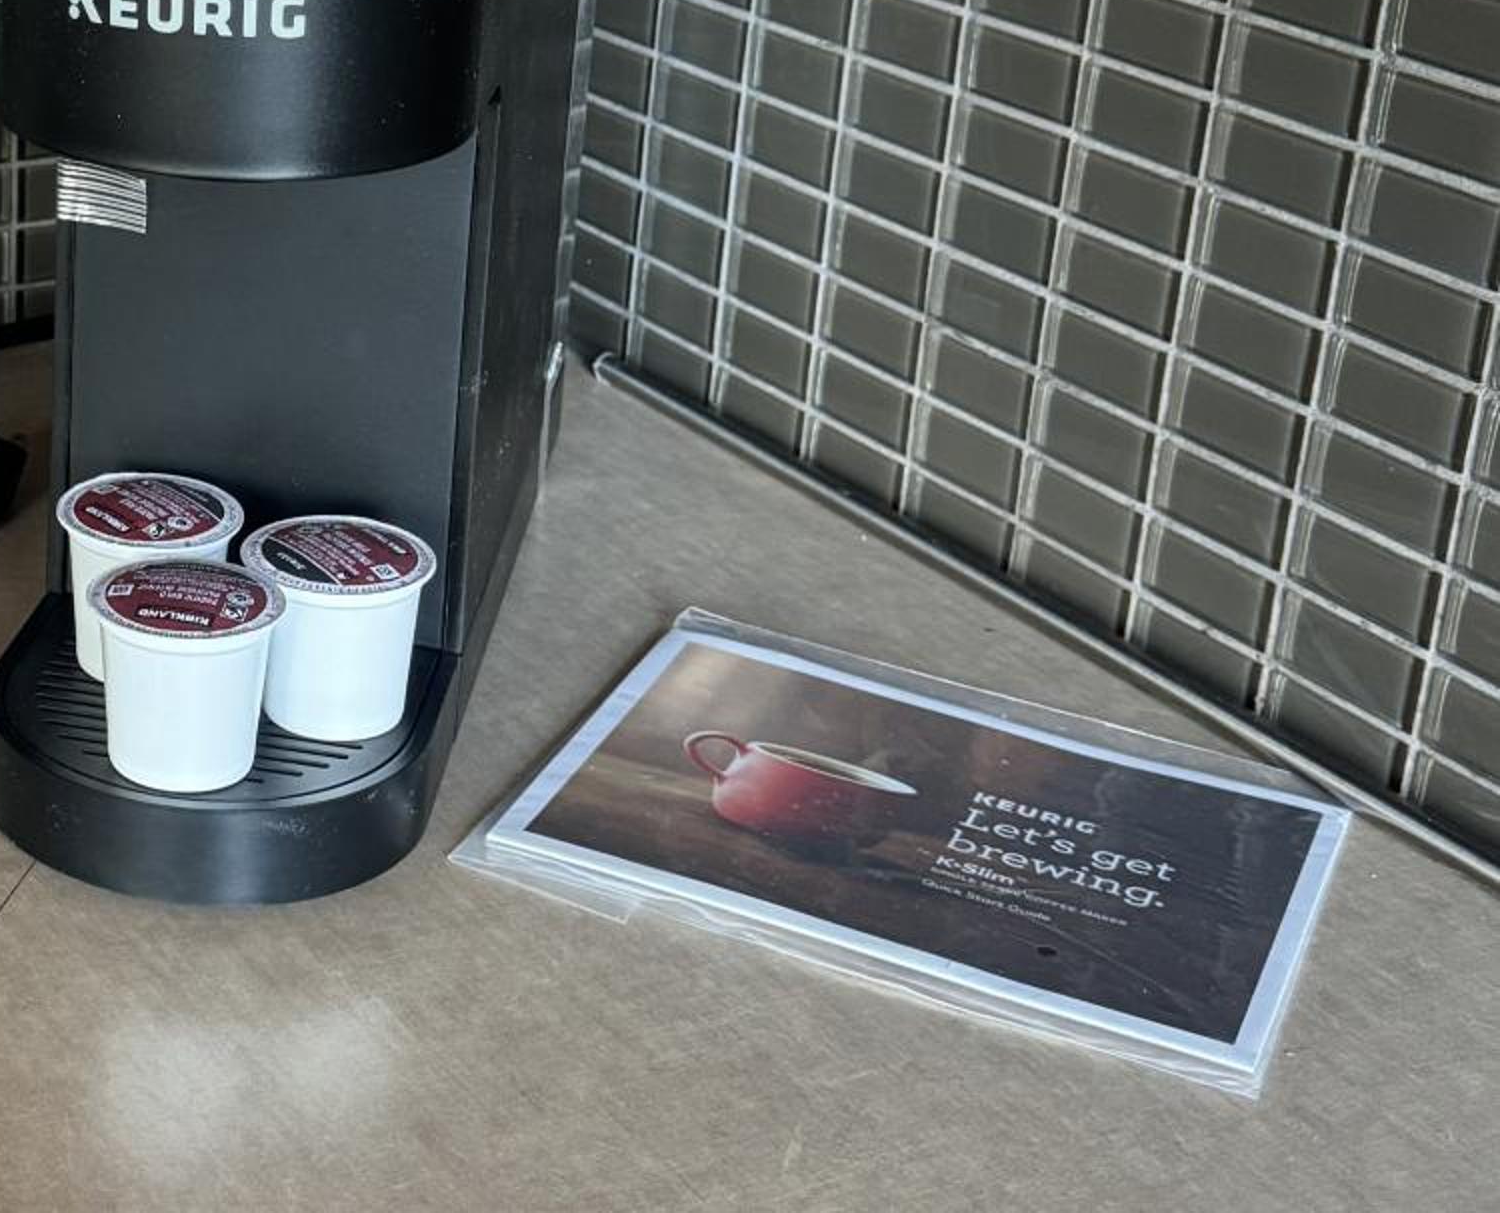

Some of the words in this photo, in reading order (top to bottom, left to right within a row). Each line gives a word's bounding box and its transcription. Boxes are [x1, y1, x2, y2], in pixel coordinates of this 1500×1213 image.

[138, 608, 210, 626] KIRKLAND
[972, 791, 1099, 835] KEURIG
[948, 829, 1166, 909] brewing.
[959, 807, 1076, 855] Let's
[1091, 849, 1177, 892] get
